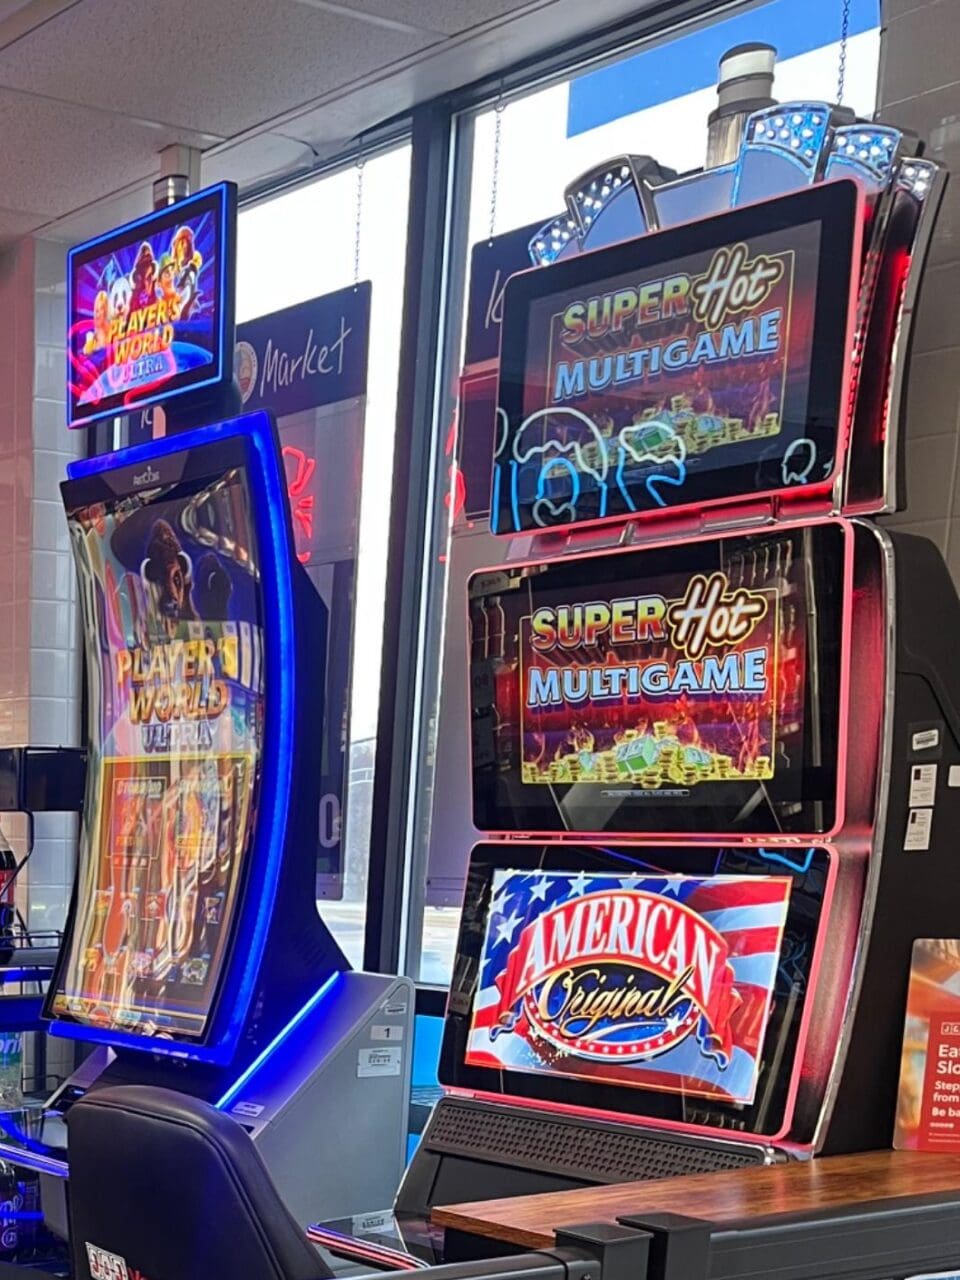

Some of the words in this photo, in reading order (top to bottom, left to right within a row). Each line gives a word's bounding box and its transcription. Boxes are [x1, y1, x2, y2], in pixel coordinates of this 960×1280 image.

[108, 298, 181, 343] PLAYER'S
[563, 273, 691, 343] SUPER
[695, 247, 781, 328] Hot
[114, 324, 174, 366] WORLD
[259, 317, 352, 397] Market
[553, 309, 782, 401] MULTIGAME
[531, 596, 667, 652] SUPER
[671, 574, 764, 656] Hot
[130, 679, 230, 725] WORLD
[527, 648, 768, 708] MULTIGAME
[516, 896, 720, 1006] AMERICAN
[540, 966, 697, 1037] Original
[384, 1027, 390, 1038] 1
[938, 1044, 960, 1058] Ea
[932, 1107, 946, 1117] Be
